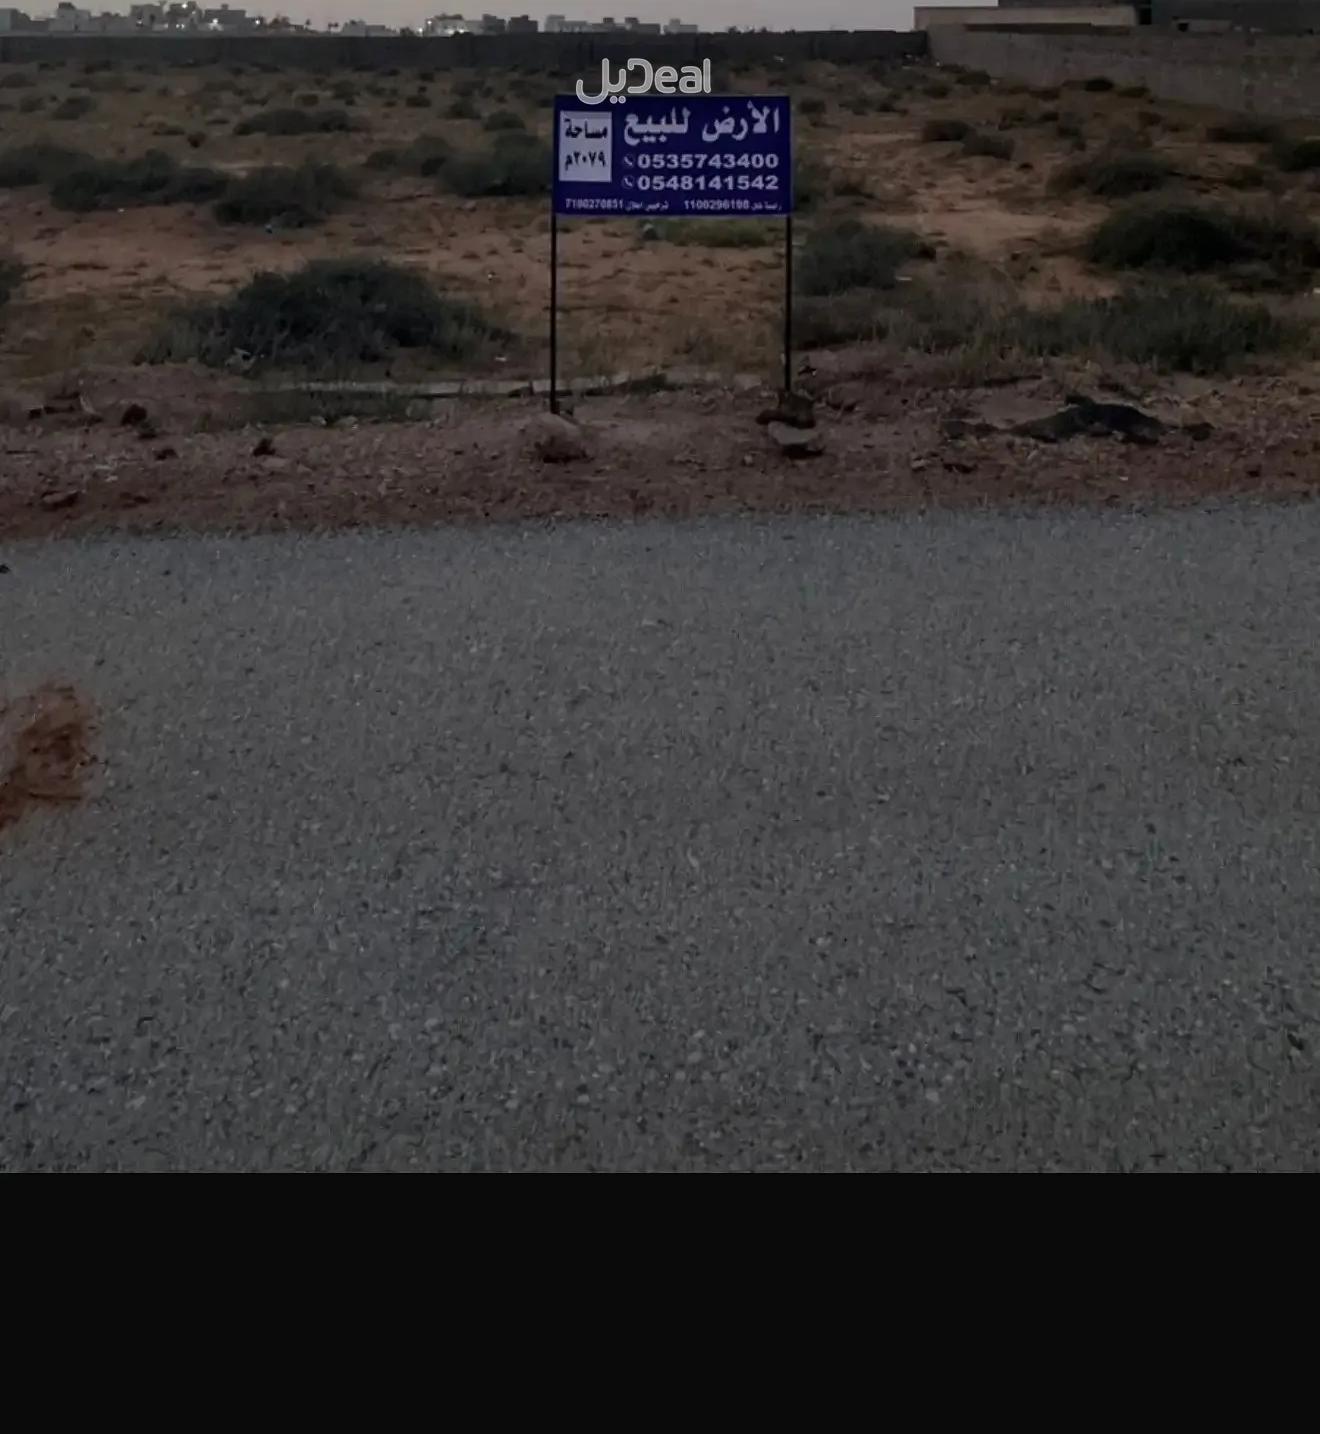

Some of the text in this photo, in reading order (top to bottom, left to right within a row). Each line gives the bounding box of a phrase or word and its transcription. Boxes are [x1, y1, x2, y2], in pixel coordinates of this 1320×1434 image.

[564, 117, 608, 139] مساحة
[623, 100, 780, 146] الأرض للبيع
[637, 153, 779, 169] 0535743400
[637, 175, 779, 191] 0548141542
